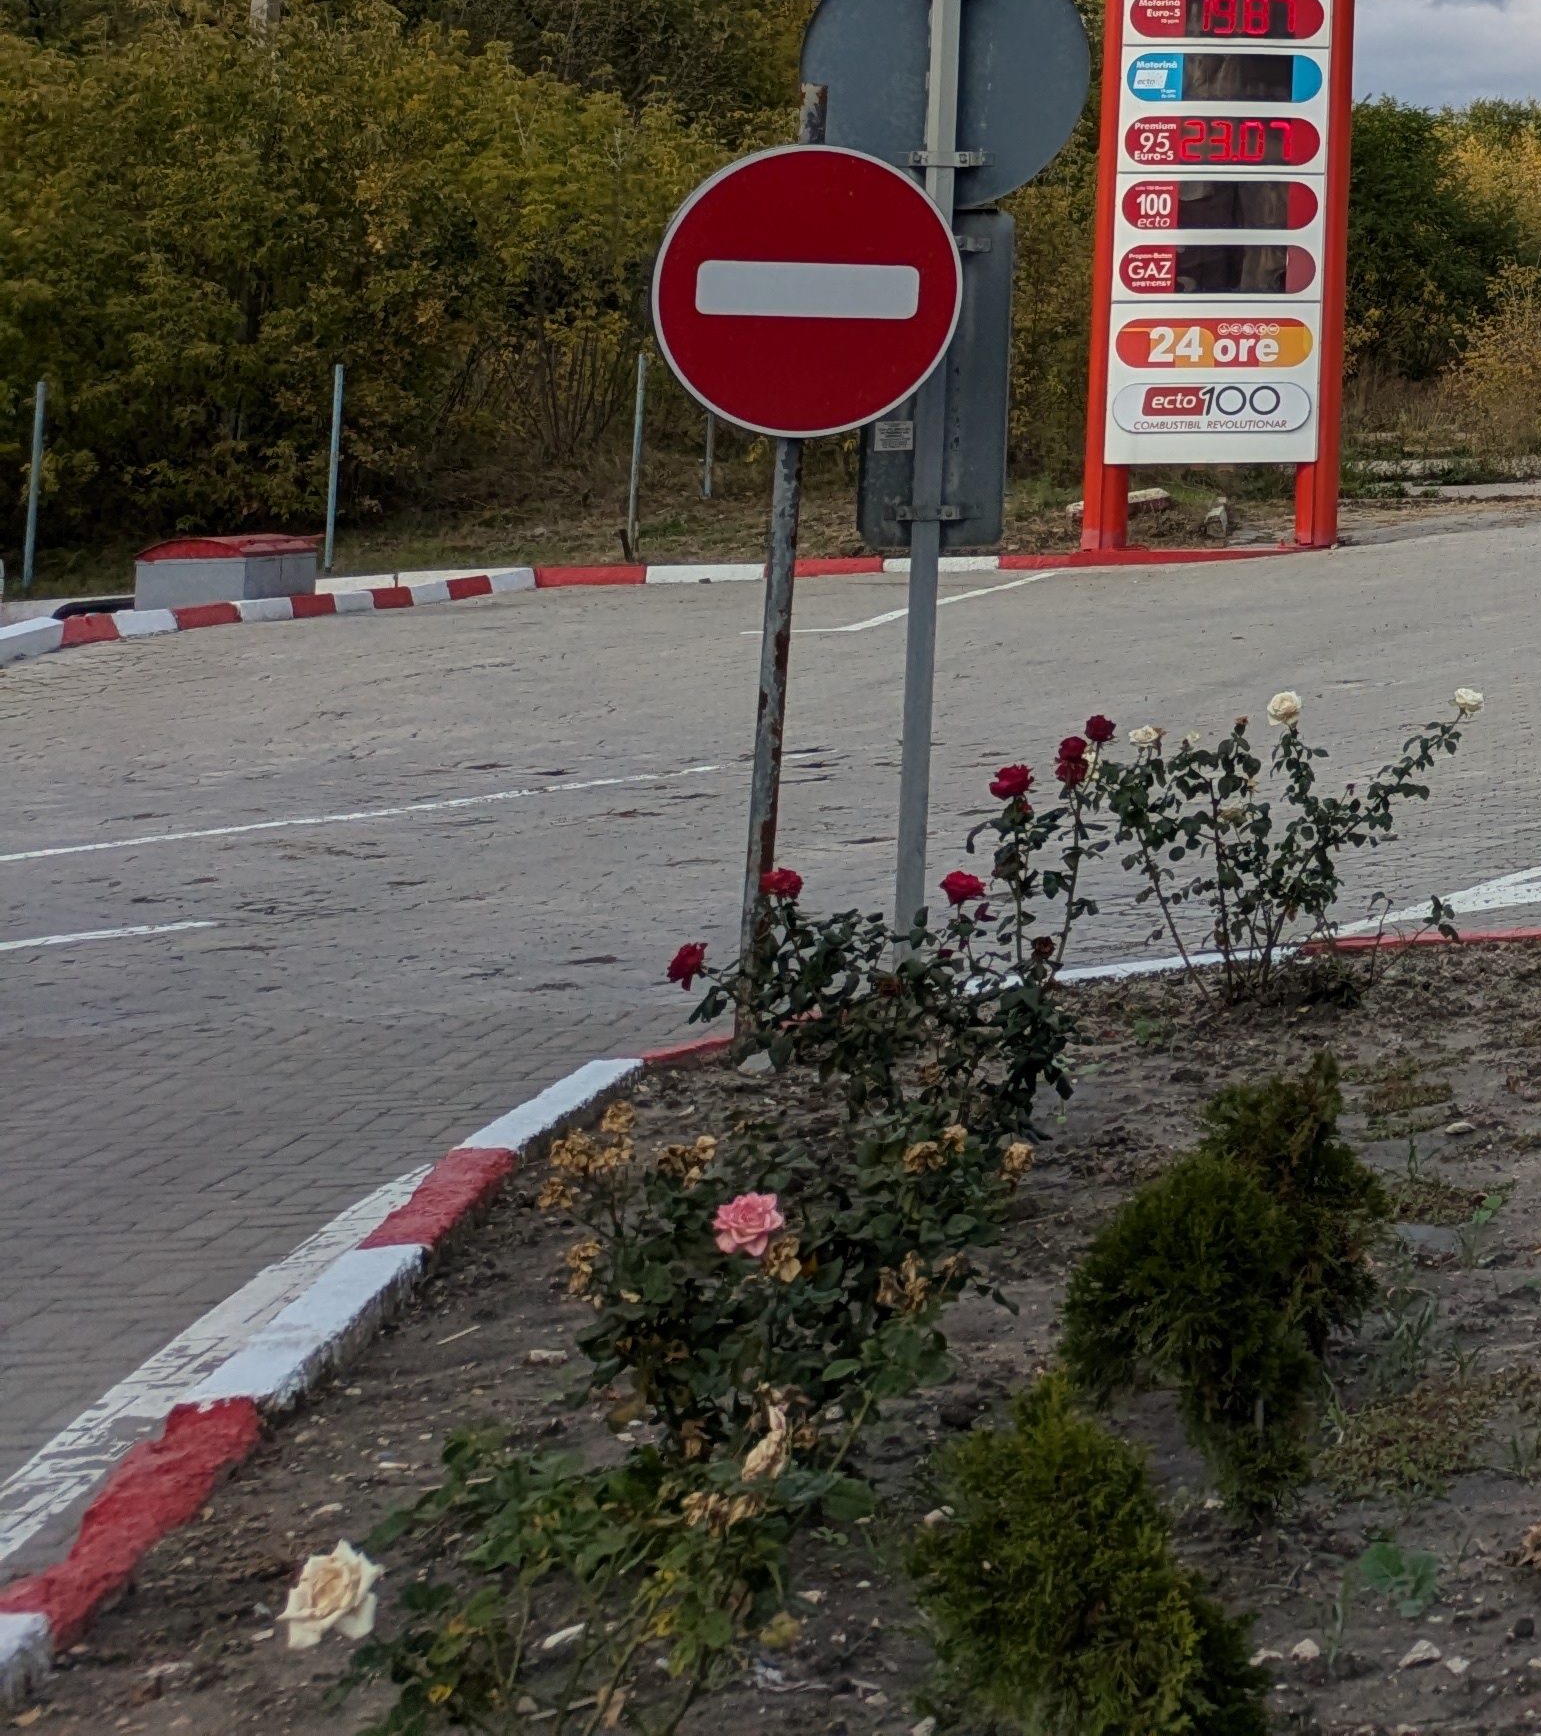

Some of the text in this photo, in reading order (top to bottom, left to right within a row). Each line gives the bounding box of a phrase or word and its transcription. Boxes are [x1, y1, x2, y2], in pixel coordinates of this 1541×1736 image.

[1146, 8, 1181, 18] Euro-5
[1134, 121, 1177, 131] Premium
[1139, 132, 1170, 153] 95
[1180, 120, 1292, 162] 23.07
[1134, 151, 1174, 161] Euro-5
[1136, 193, 1172, 216] 100
[1137, 216, 1171, 228] ecto
[1128, 261, 1172, 279] GAZ
[1148, 326, 1280, 363] 24 ore
[1133, 420, 1201, 431] COMBUSTIBIL
